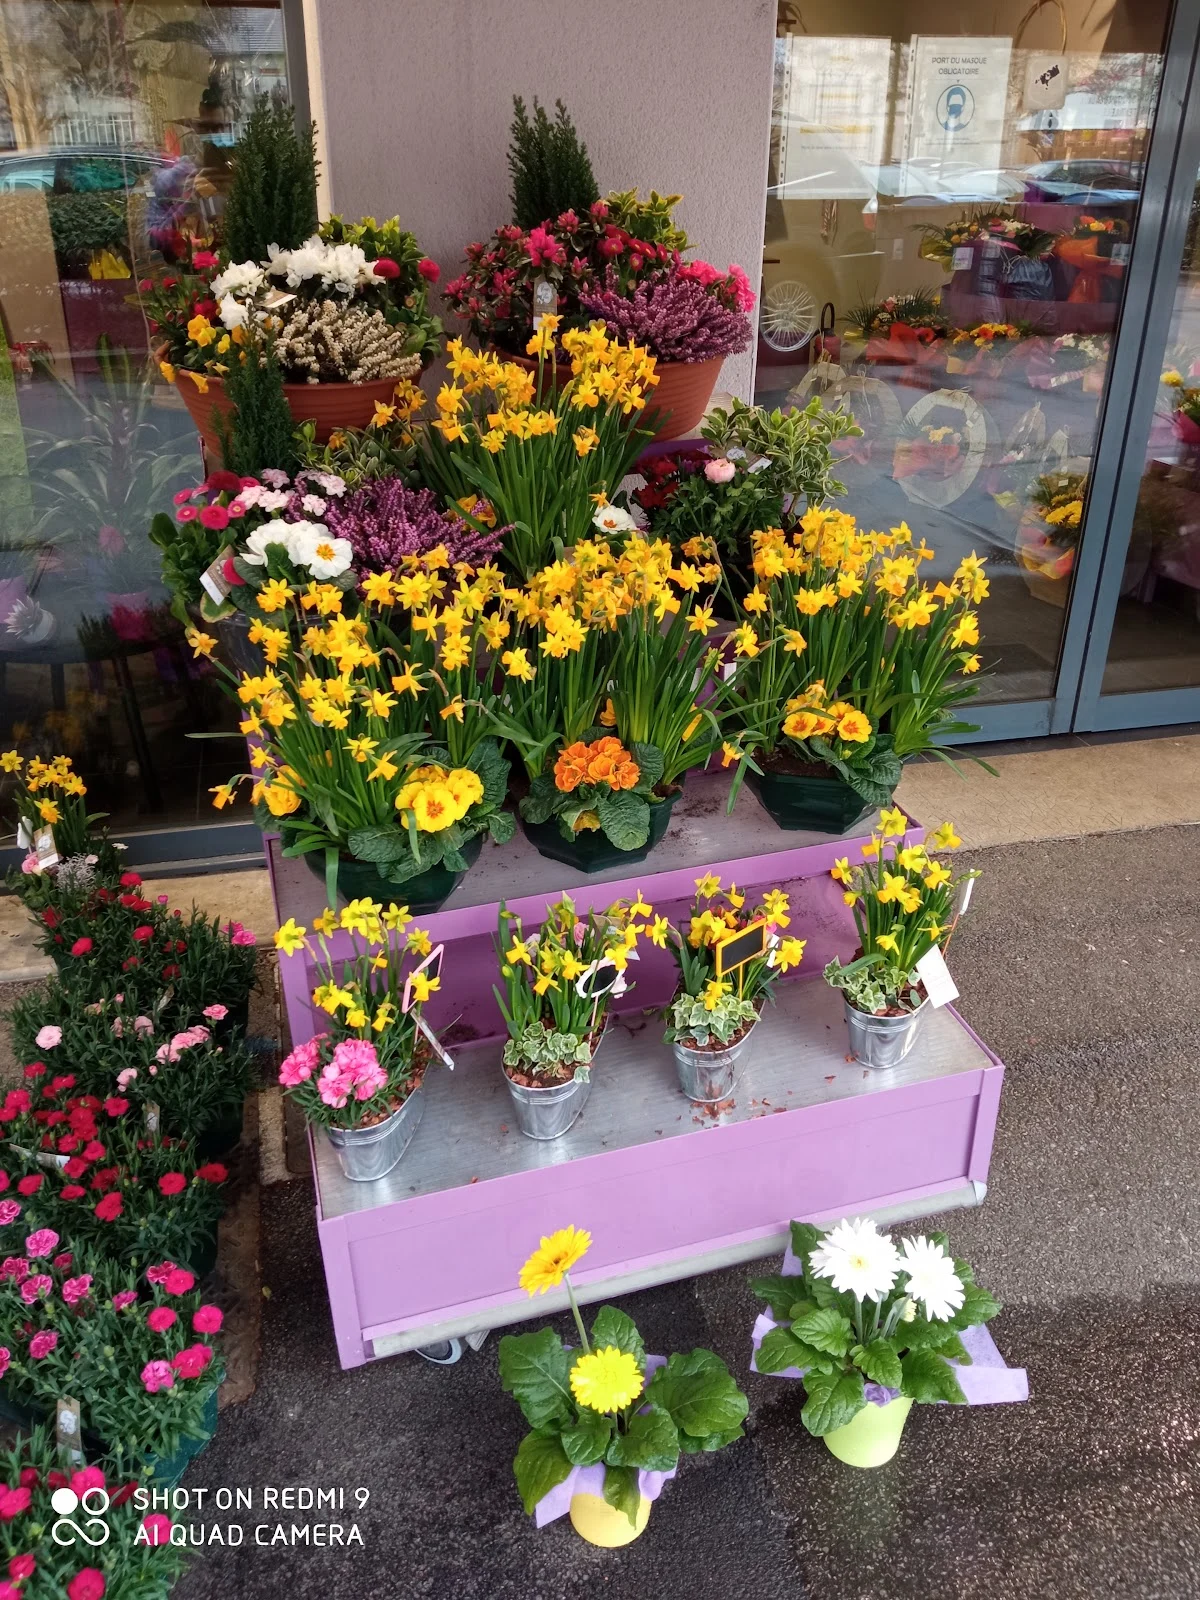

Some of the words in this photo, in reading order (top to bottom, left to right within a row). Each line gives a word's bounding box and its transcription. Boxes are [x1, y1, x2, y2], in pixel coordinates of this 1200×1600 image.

[931, 57, 950, 65] PORT
[951, 57, 961, 65] DU
[961, 57, 988, 65] MASQUE
[938, 67, 980, 75] OBLIGATOIRE
